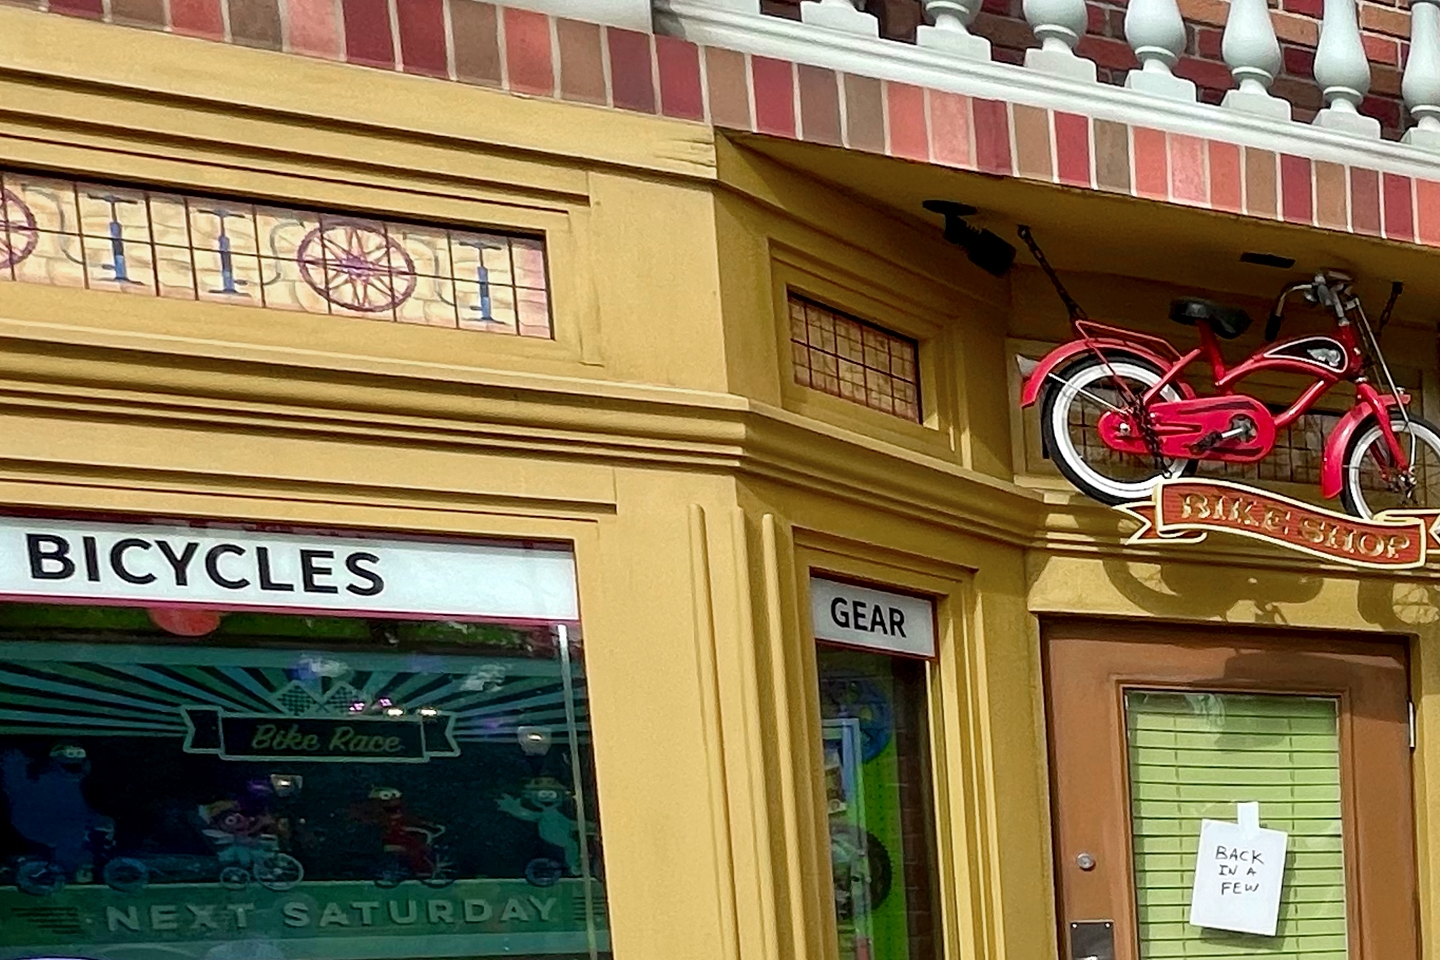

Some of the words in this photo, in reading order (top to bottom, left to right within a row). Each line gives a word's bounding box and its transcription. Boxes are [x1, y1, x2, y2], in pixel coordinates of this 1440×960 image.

[1179, 491, 1290, 536] BIKE
[1297, 515, 1411, 560] SHOP
[25, 532, 385, 597] BICYCLES
[830, 596, 907, 638] GEAR
[251, 724, 320, 751] Bike
[328, 726, 405, 752] Race
[1215, 845, 1264, 865] BACK
[1218, 864, 1238, 876] IN
[1246, 867, 1257, 876] A
[1221, 881, 1260, 896] FEW
[106, 902, 255, 932] NEXT
[283, 897, 557, 927] SATURDAY
